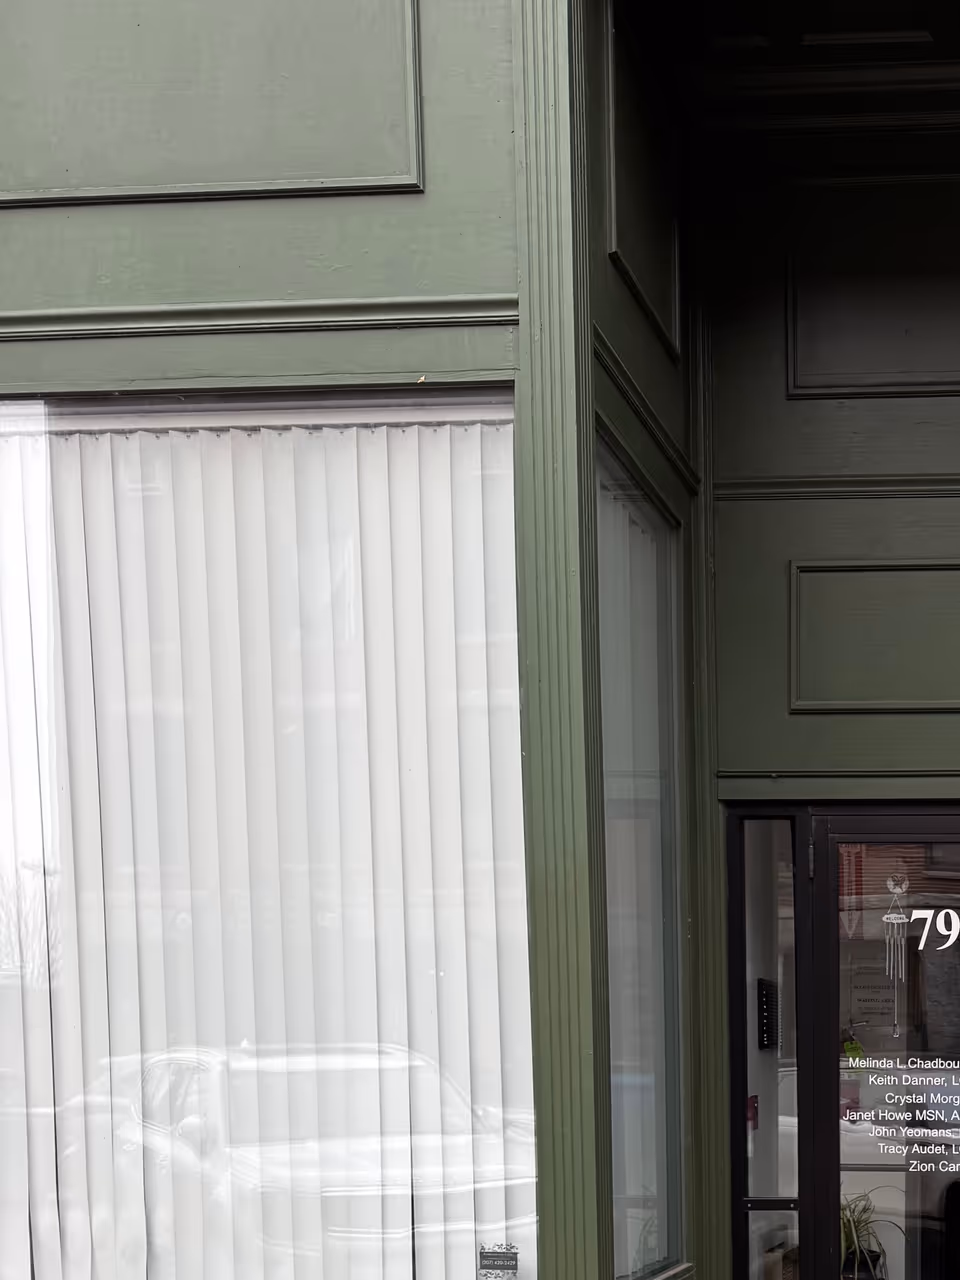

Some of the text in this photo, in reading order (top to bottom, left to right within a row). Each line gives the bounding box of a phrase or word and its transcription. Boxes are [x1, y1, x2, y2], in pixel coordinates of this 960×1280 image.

[910, 909, 960, 950] 79
[848, 1057, 893, 1068] Melinda
[896, 1058, 906, 1068] L.
[869, 1074, 899, 1086] Keith
[902, 1074, 947, 1087] Danner,
[885, 1092, 926, 1106] Crystal
[843, 1109, 875, 1121] Janet
[878, 1109, 912, 1121] Howe
[915, 1110, 948, 1122] MSN,
[869, 1126, 897, 1137] John
[900, 1127, 955, 1138] Yeomans,
[877, 1143, 909, 1156] Tracy
[911, 1143, 948, 1156] Audet,
[909, 1161, 935, 1172] Zion
